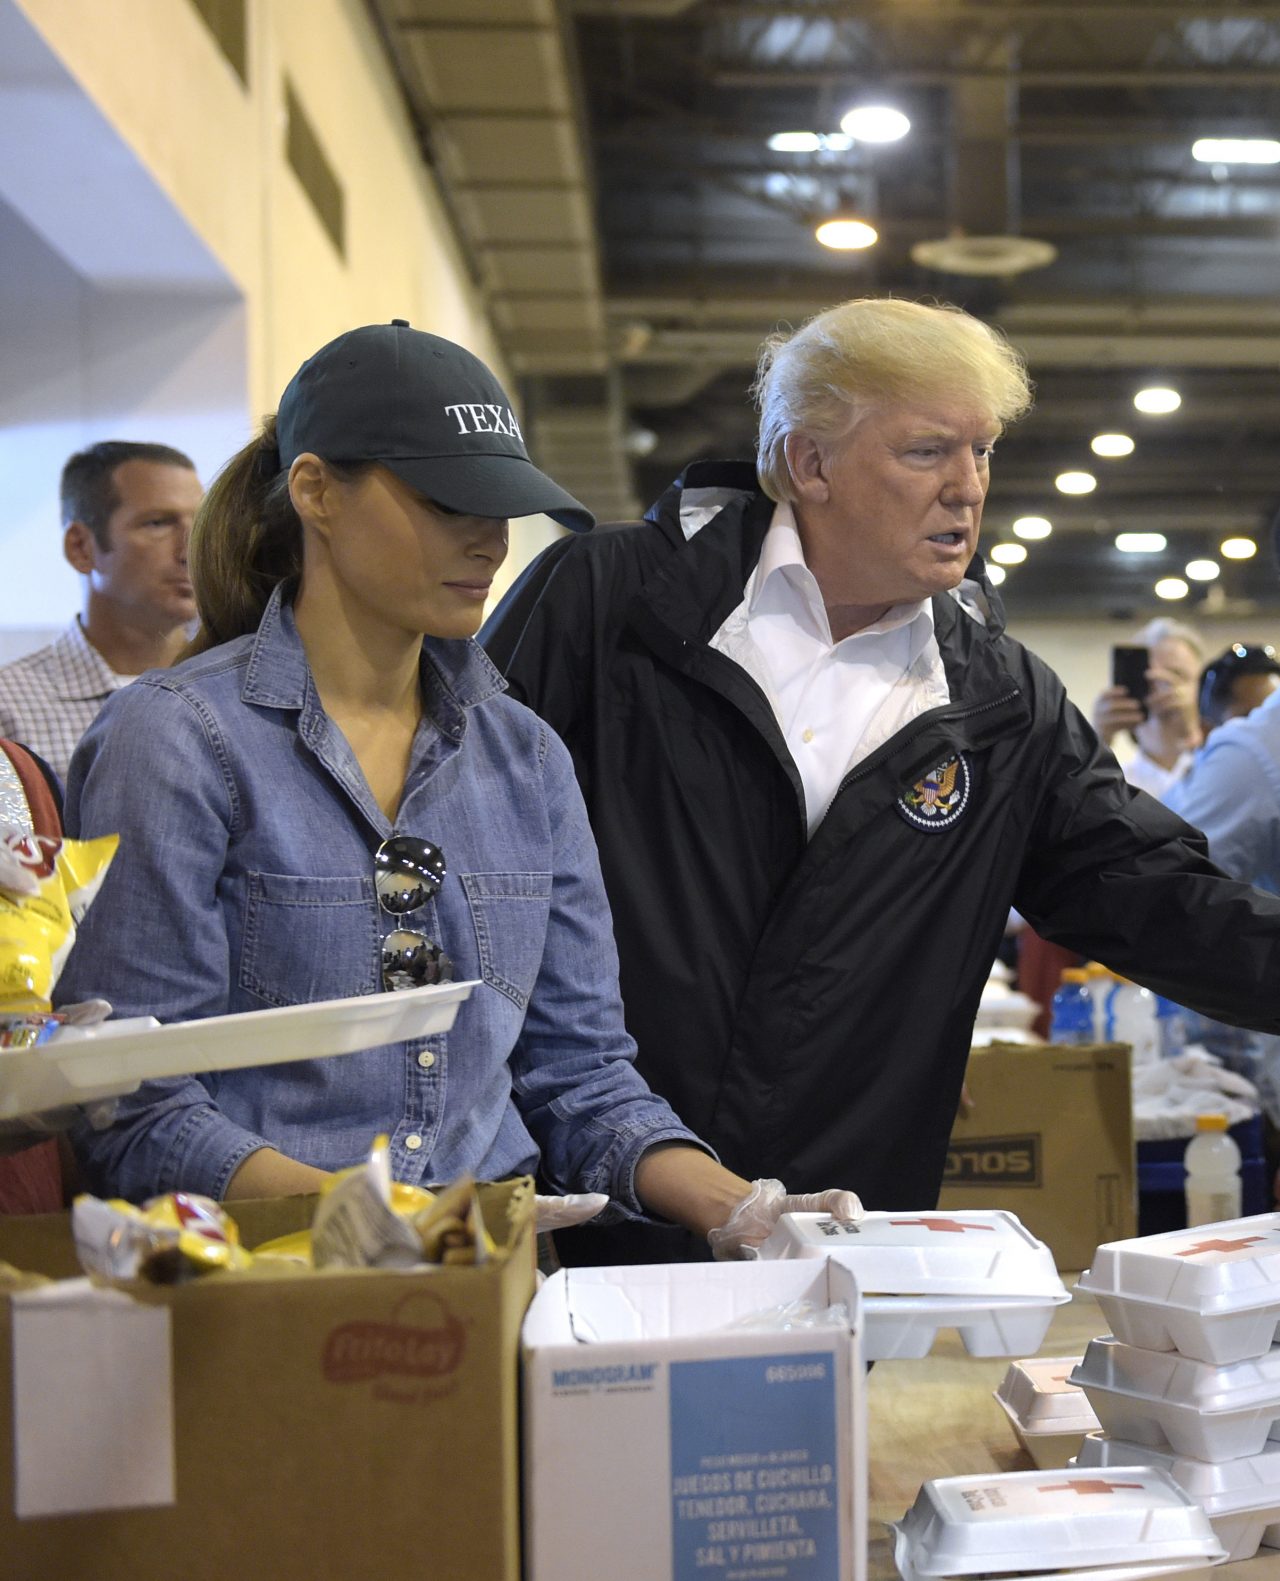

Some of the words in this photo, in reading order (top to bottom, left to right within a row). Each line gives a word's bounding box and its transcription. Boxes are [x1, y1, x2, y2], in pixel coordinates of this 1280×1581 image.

[444, 403, 524, 443] TEXA
[673, 1472, 732, 1495] JUEGOS
[734, 1470, 754, 1491] DE
[696, 1546, 726, 1568] SAL
[728, 1545, 740, 1564] Y
[742, 1538, 817, 1562] PIMIENTA
